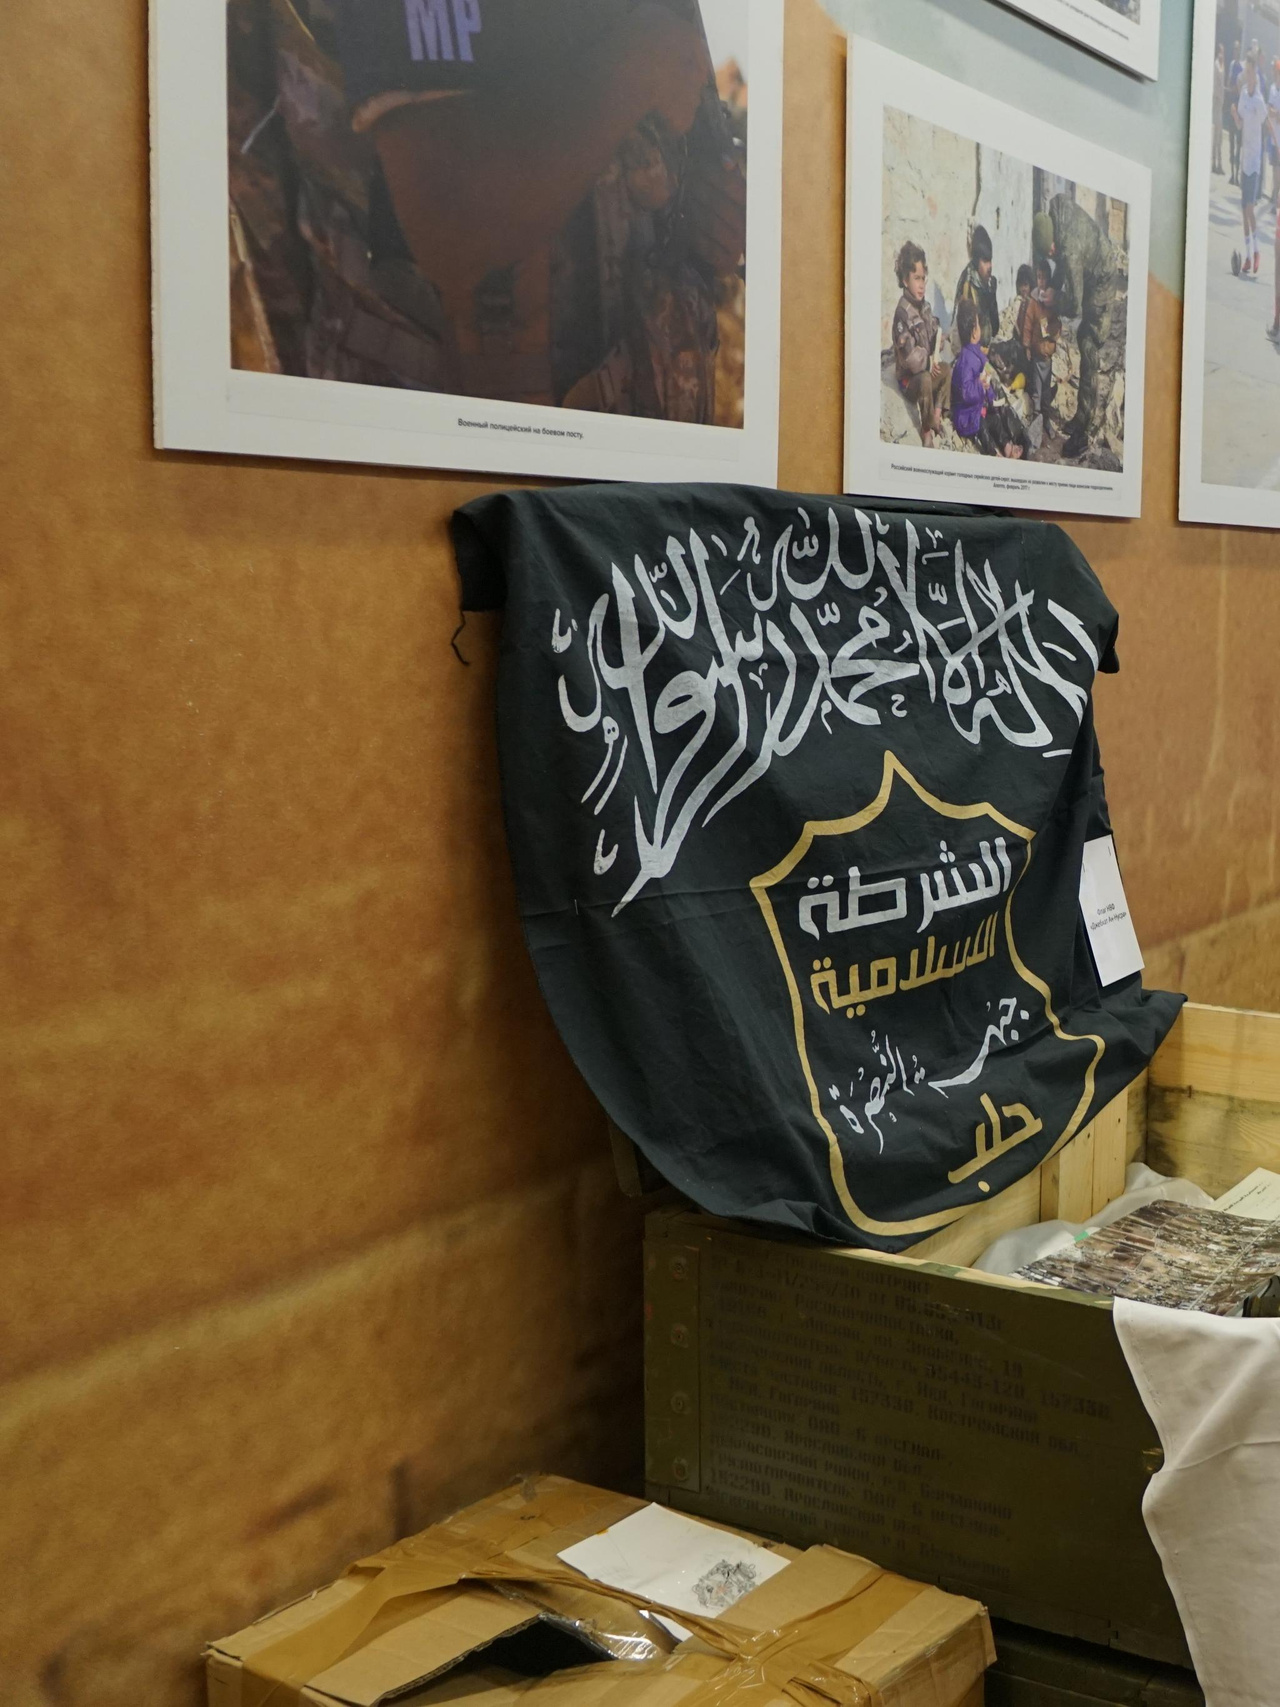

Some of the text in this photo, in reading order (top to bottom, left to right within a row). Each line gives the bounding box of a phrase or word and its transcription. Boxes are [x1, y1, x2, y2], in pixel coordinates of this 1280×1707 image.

[457, 417, 584, 441] Военный полицейский на боевом посту.
[798, 835, 1013, 941] الشرطة
[948, 1092, 1043, 1193] حلب
